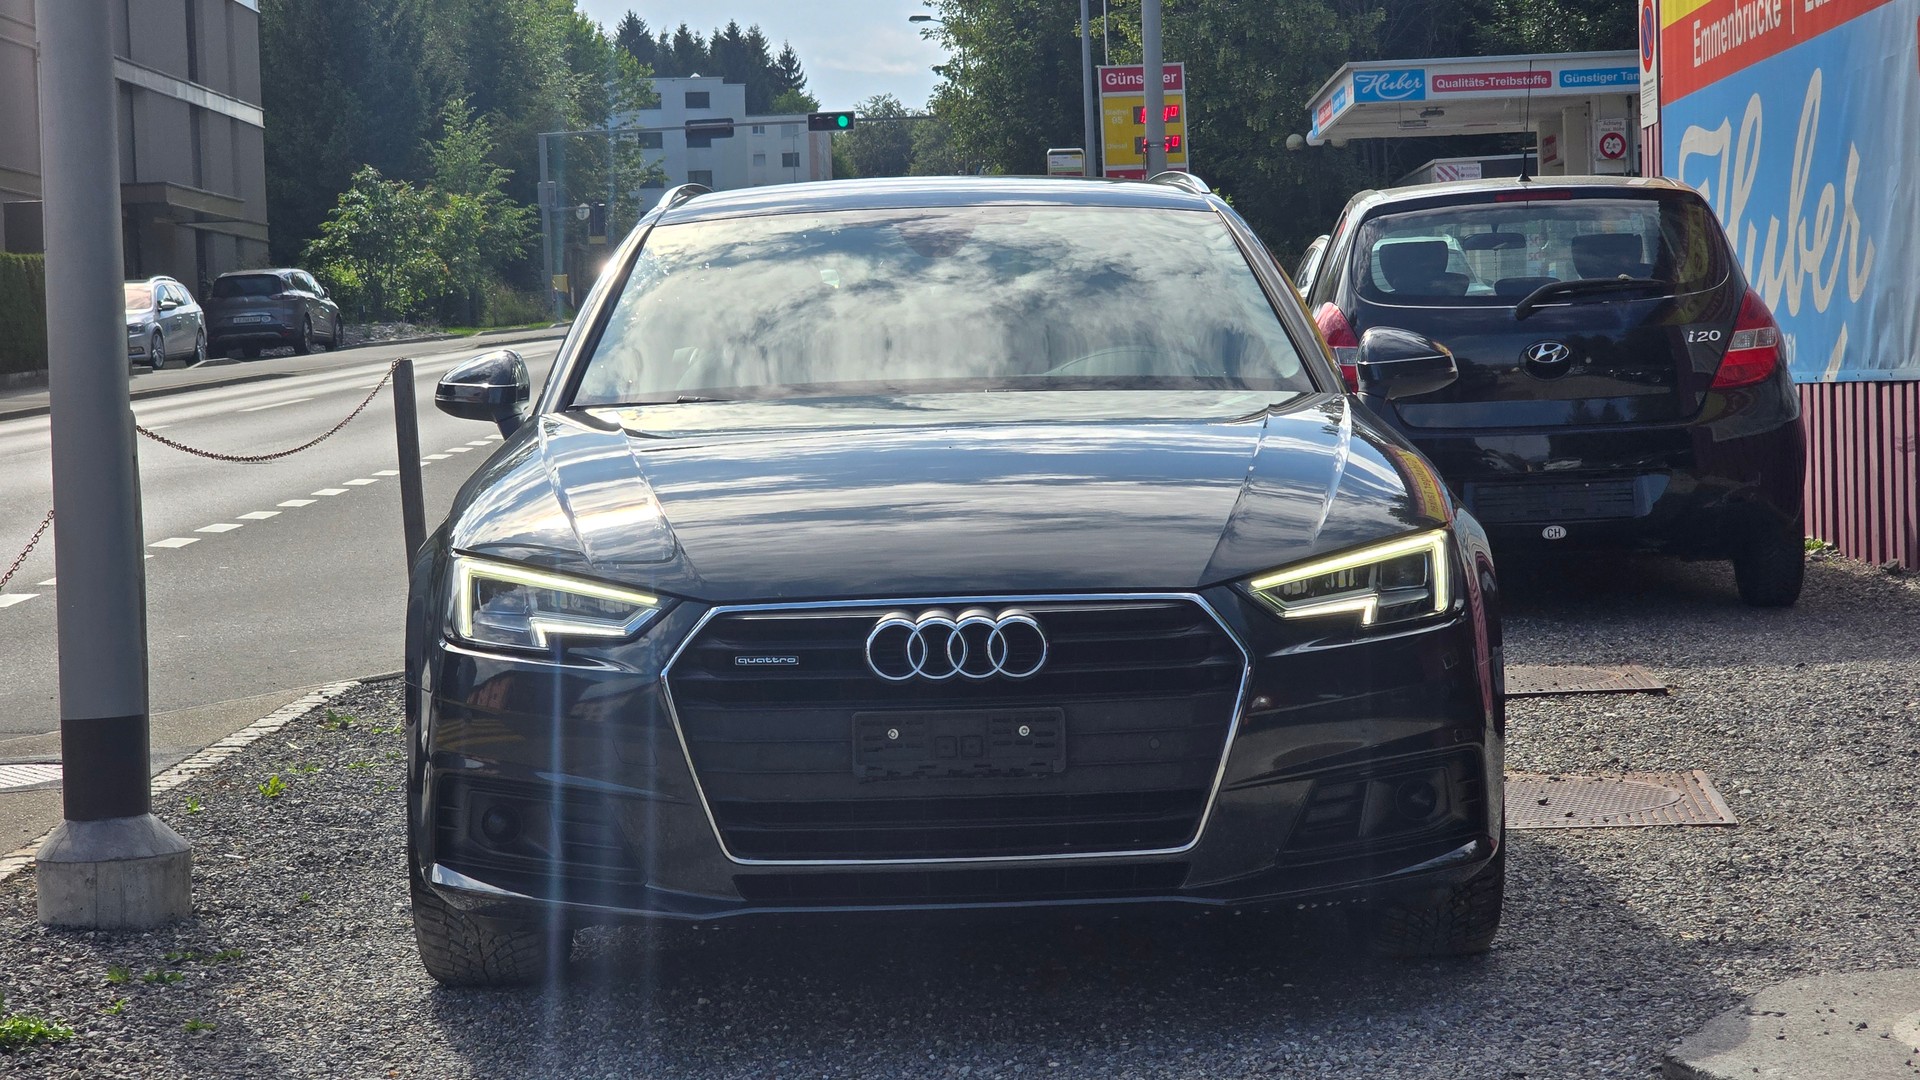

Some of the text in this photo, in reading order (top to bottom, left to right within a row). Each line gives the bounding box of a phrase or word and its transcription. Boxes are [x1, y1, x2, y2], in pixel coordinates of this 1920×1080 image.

[1436, 75, 1548, 89] Qualitäts-Treibstoffe
[1563, 72, 1617, 84] Günstiger
[1355, 72, 1423, 100] Huber
[1678, 67, 1875, 381] Huber
[1547, 528, 1561, 539] CH
[737, 657, 796, 665] quattro
